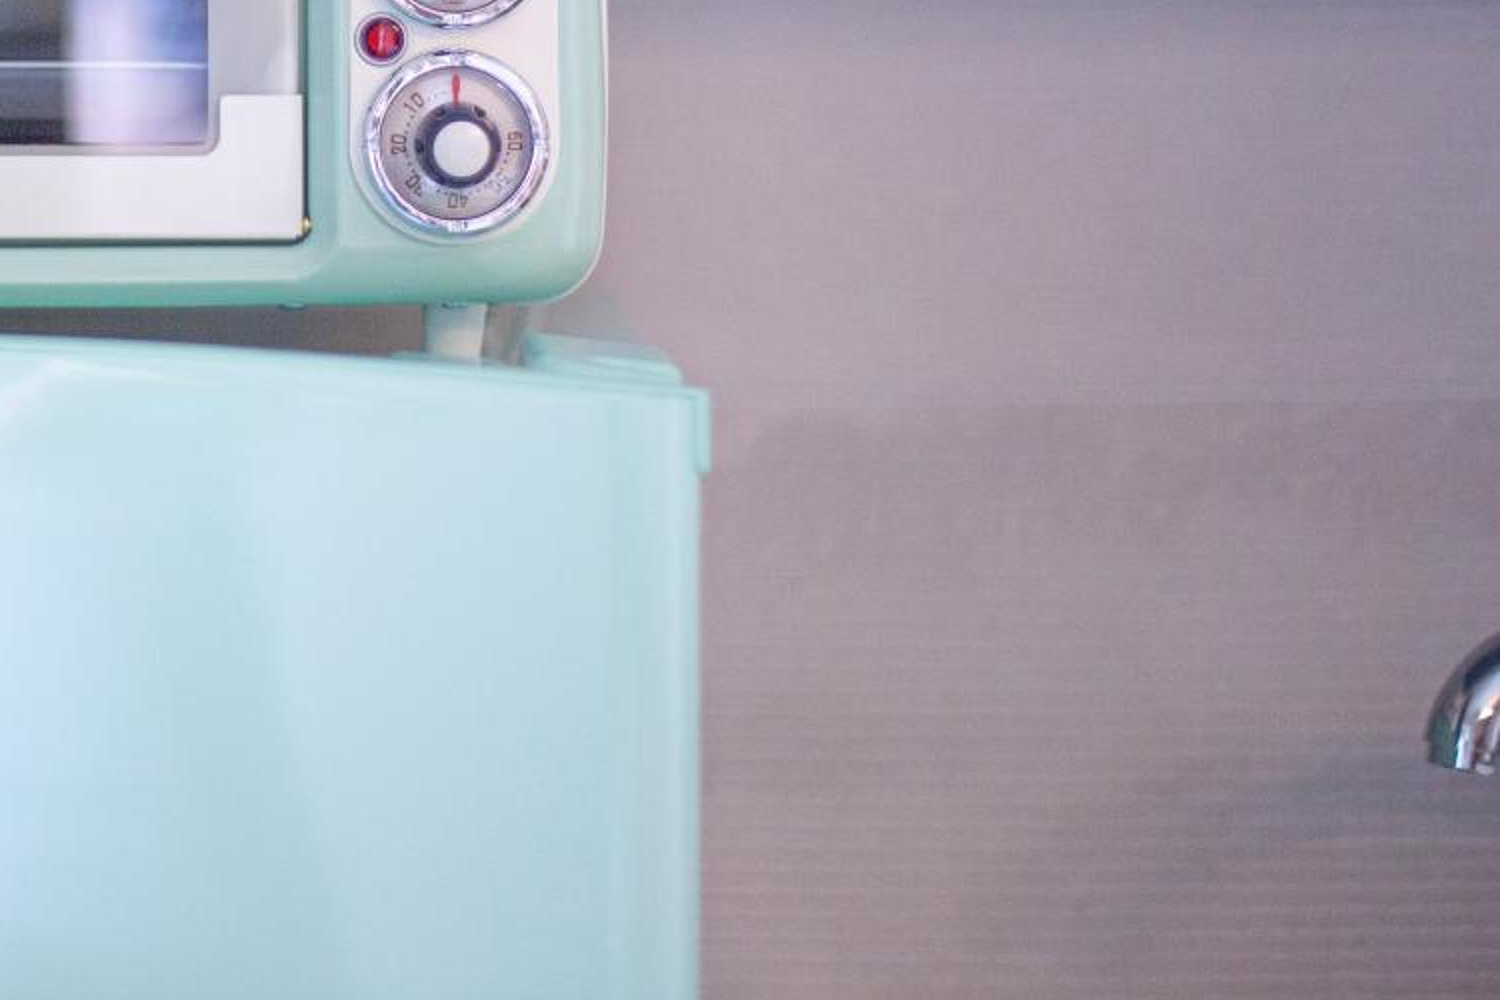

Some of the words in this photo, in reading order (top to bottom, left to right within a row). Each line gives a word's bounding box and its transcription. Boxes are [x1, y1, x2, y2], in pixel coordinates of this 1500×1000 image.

[404, 92, 424, 113] 10
[391, 134, 406, 155] 20
[508, 131, 523, 151] 60
[448, 192, 468, 209] 40
